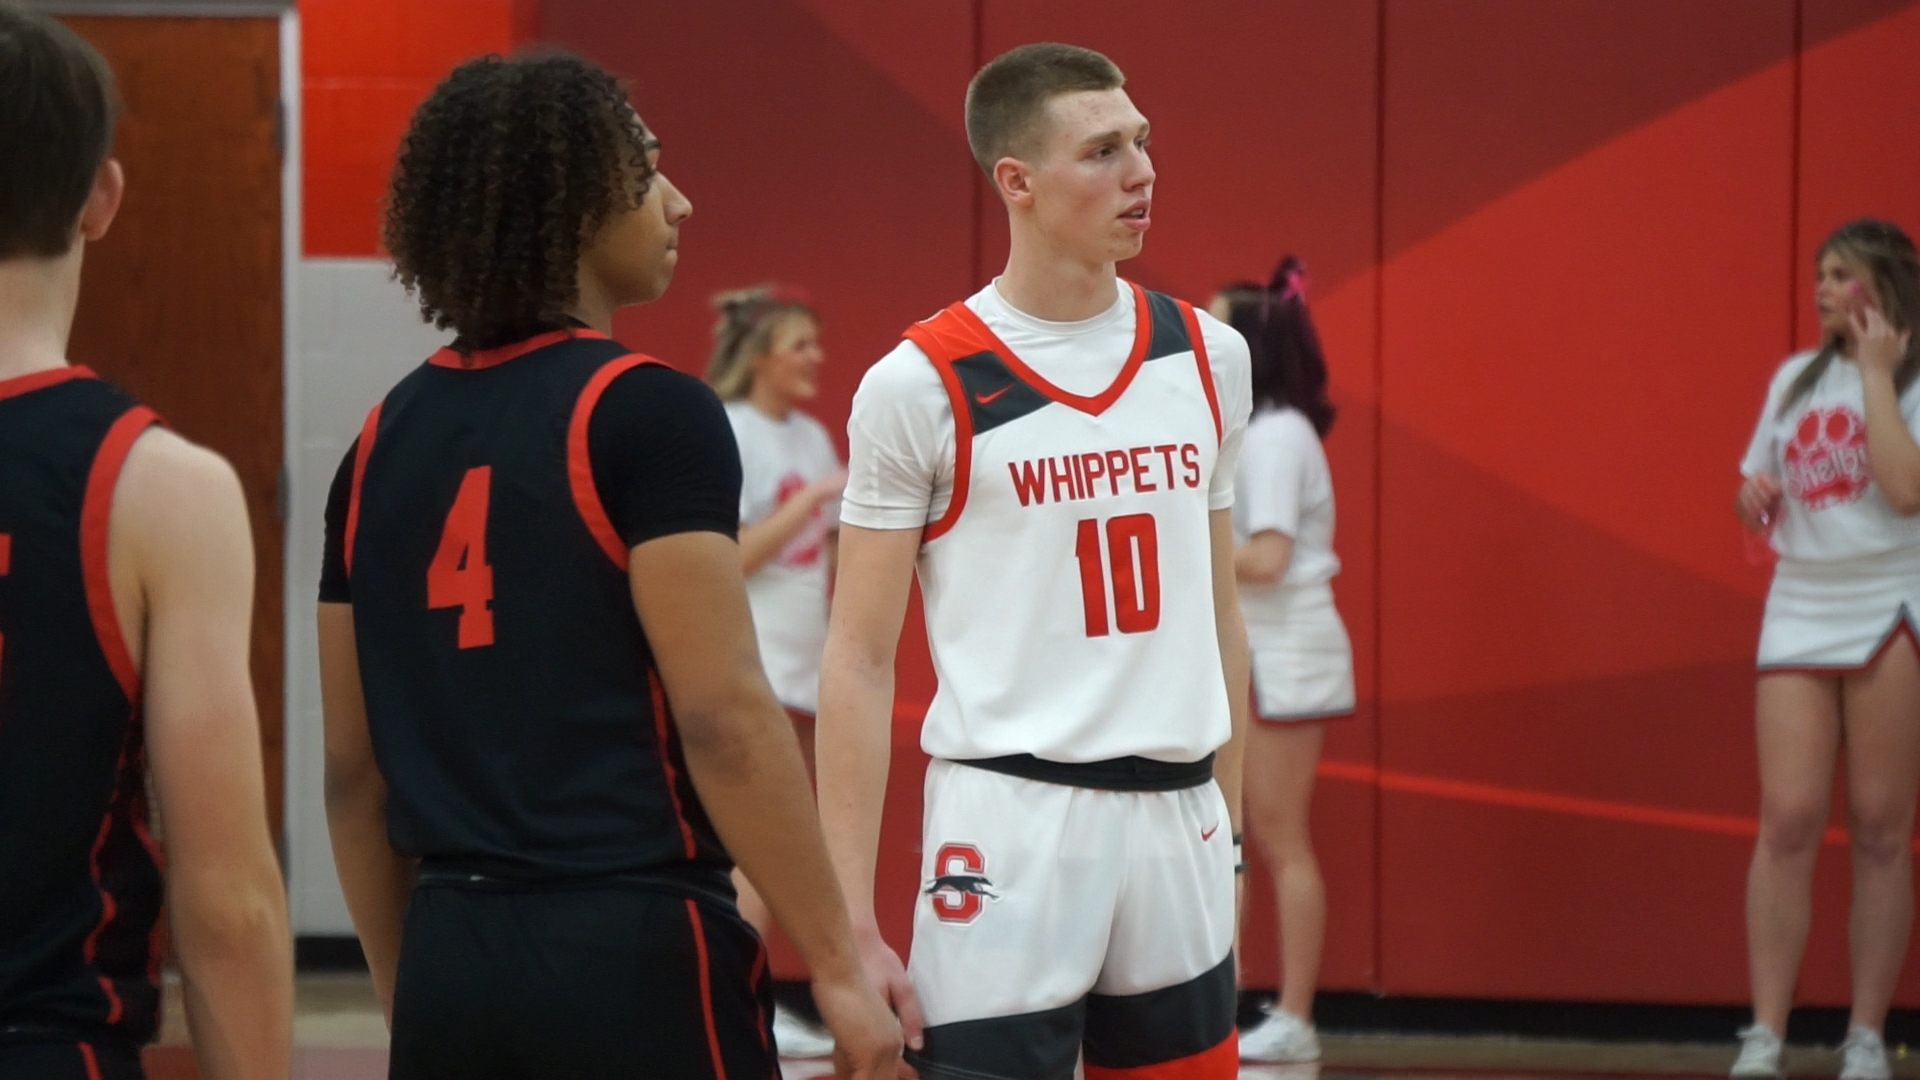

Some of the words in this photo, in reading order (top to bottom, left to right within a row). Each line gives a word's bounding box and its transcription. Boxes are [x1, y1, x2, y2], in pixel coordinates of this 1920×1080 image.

[1008, 443, 1200, 507] WHIPPETS
[427, 465, 494, 649] 4
[1075, 512, 1160, 638] 10
[932, 842, 985, 924] S
